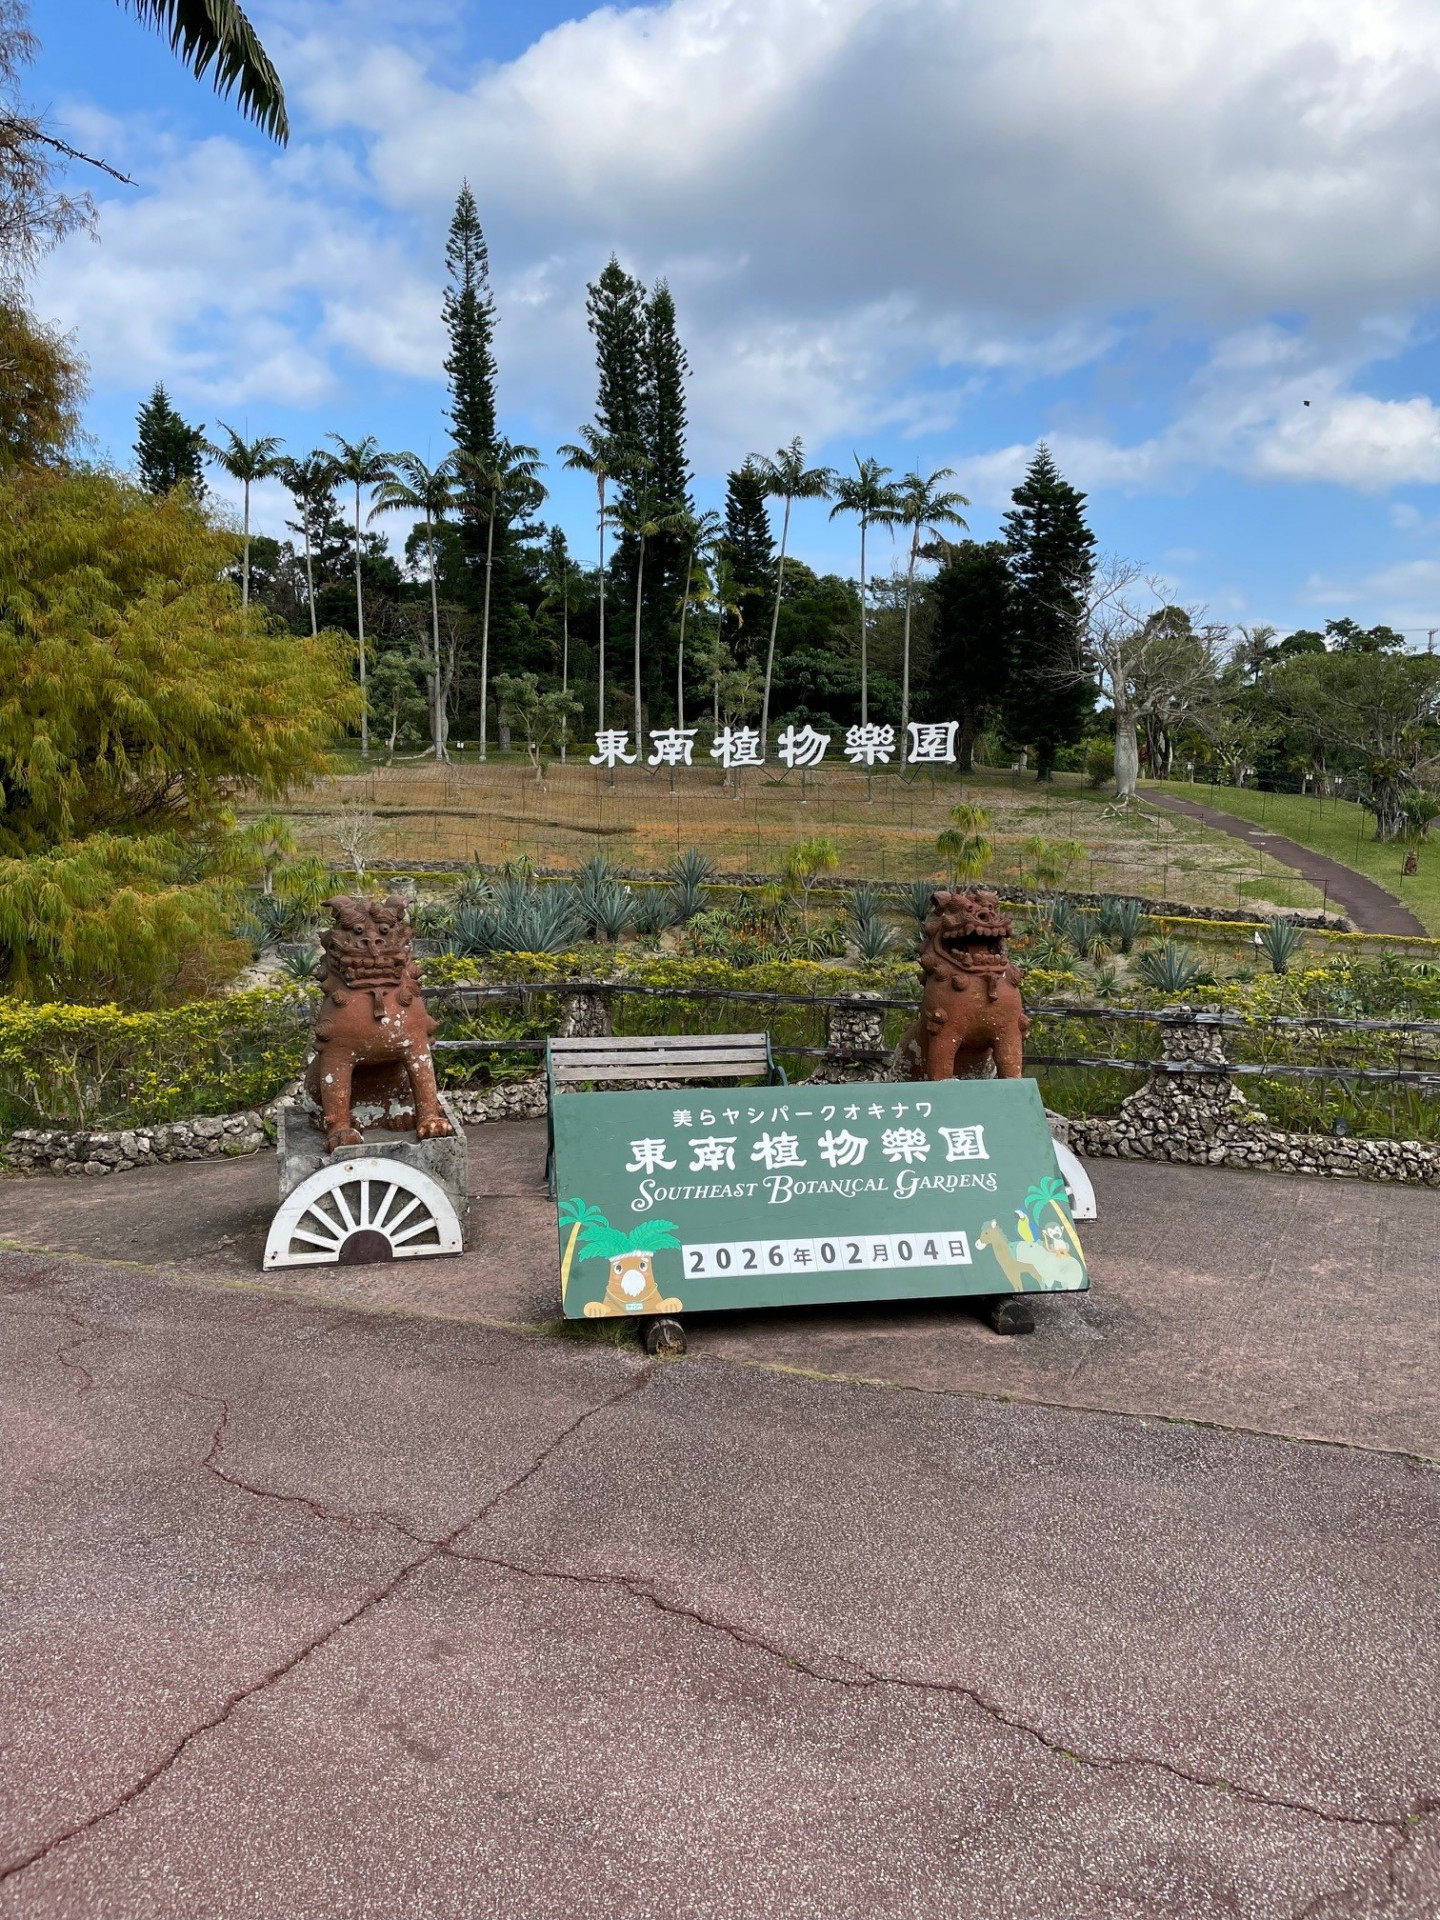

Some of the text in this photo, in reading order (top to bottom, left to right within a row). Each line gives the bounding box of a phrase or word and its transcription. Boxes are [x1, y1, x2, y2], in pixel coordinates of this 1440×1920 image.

[589, 720, 960, 768] 東南植物樂園
[672, 1102, 933, 1128] 美らヤシパークオキナワ
[625, 1124, 990, 1174] 東南植物樂園
[630, 1169, 998, 1212] SOUTHEAST BOTANICAL GARDENS
[689, 1239, 966, 1273] 2026年02月04日
